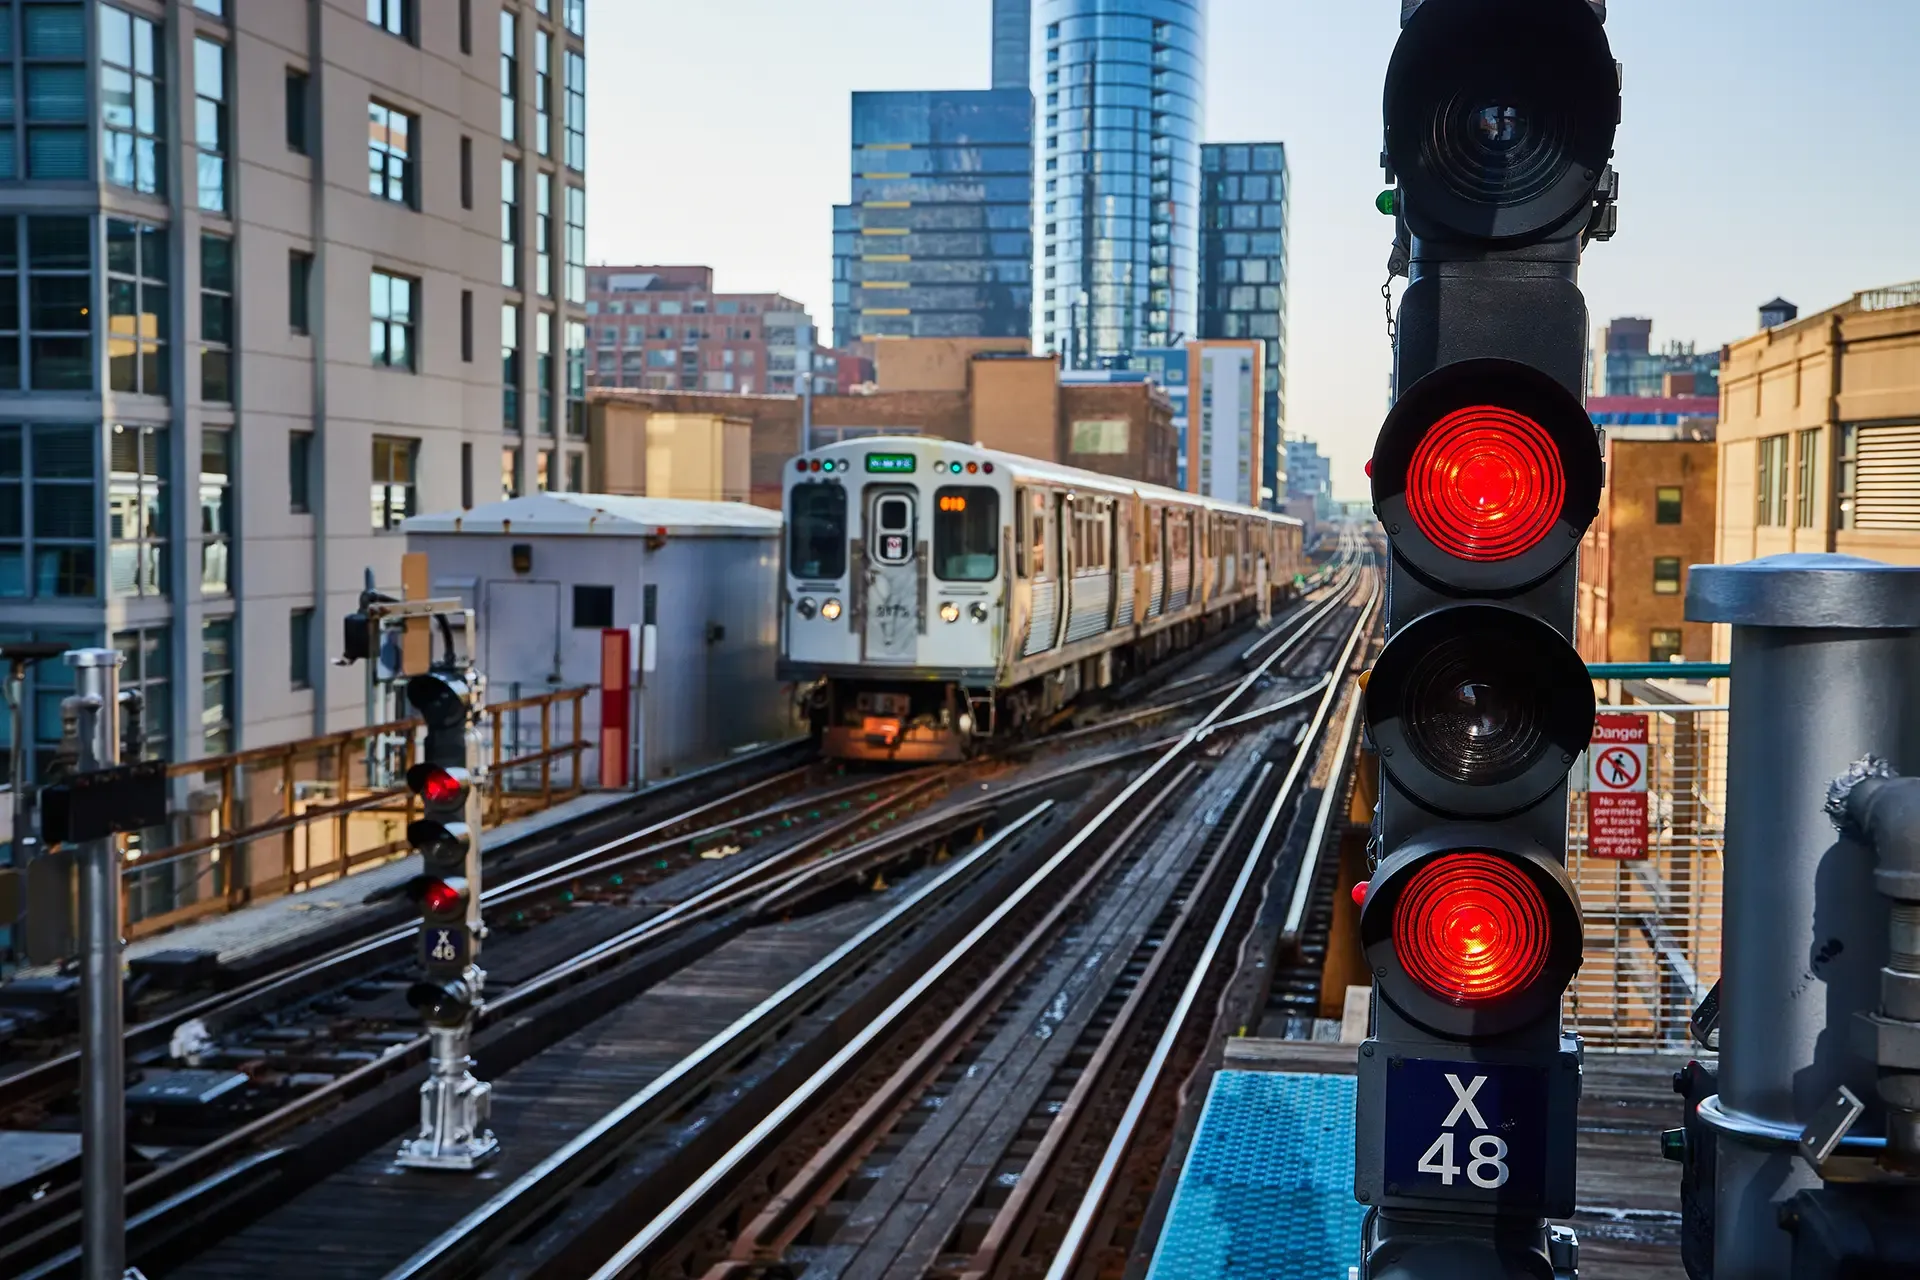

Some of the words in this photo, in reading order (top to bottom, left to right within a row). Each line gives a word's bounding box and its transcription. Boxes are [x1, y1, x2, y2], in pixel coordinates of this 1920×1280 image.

[1593, 726, 1644, 741] Danger
[1599, 797, 1614, 806] No
[1618, 798, 1637, 806] one
[1594, 807, 1643, 818] permitted
[1595, 818, 1608, 826] on
[1610, 817, 1642, 826] tracks
[1600, 827, 1635, 838] except
[1593, 836, 1642, 846] employees
[1598, 846, 1612, 854] on
[1615, 845, 1638, 856] duty
[437, 930, 450, 944] X
[1441, 1073, 1489, 1130] X
[1417, 1132, 1510, 1189] 48
